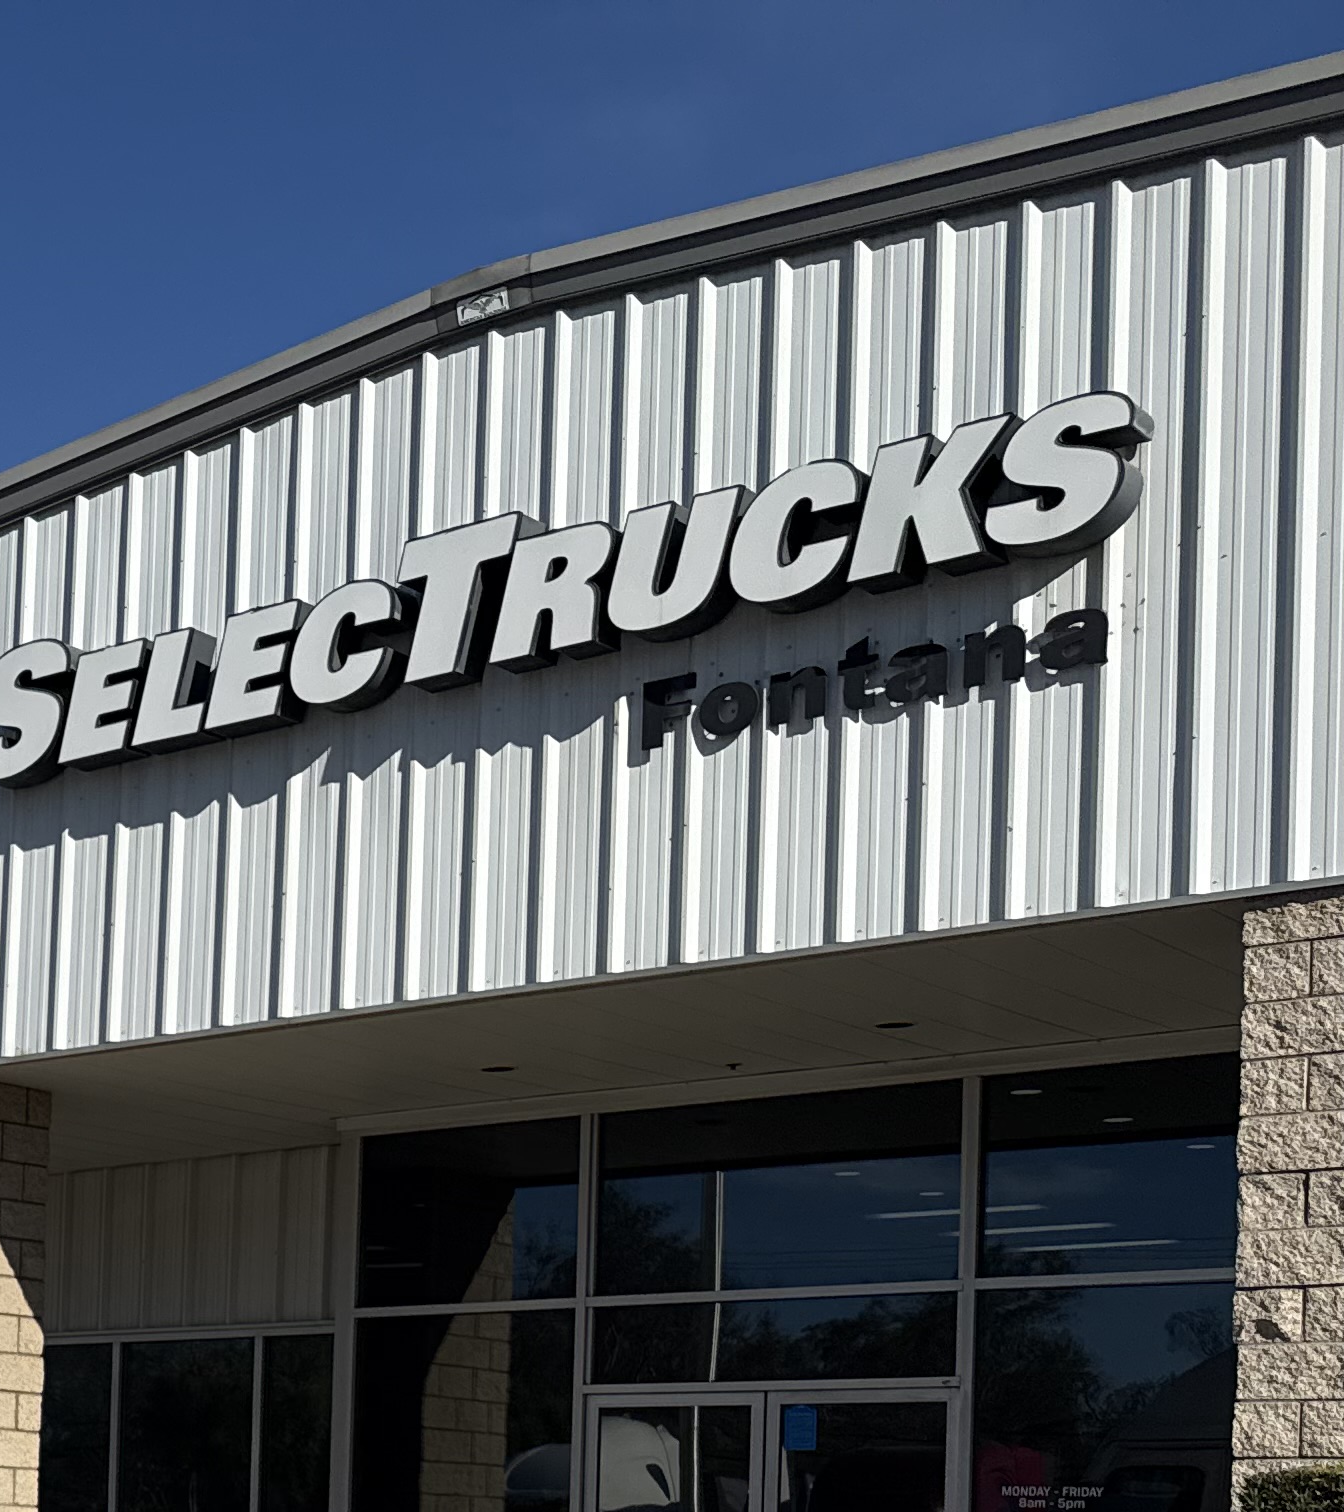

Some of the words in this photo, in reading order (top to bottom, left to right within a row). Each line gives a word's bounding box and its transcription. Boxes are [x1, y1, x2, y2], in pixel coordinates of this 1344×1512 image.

[641, 601, 1110, 752] Fontana
[1001, 1485, 1052, 1497] MONDAY
[1061, 1486, 1105, 1498] FRIDAY
[1018, 1498, 1046, 1509] 8am
[1057, 1498, 1086, 1510] 5pm
